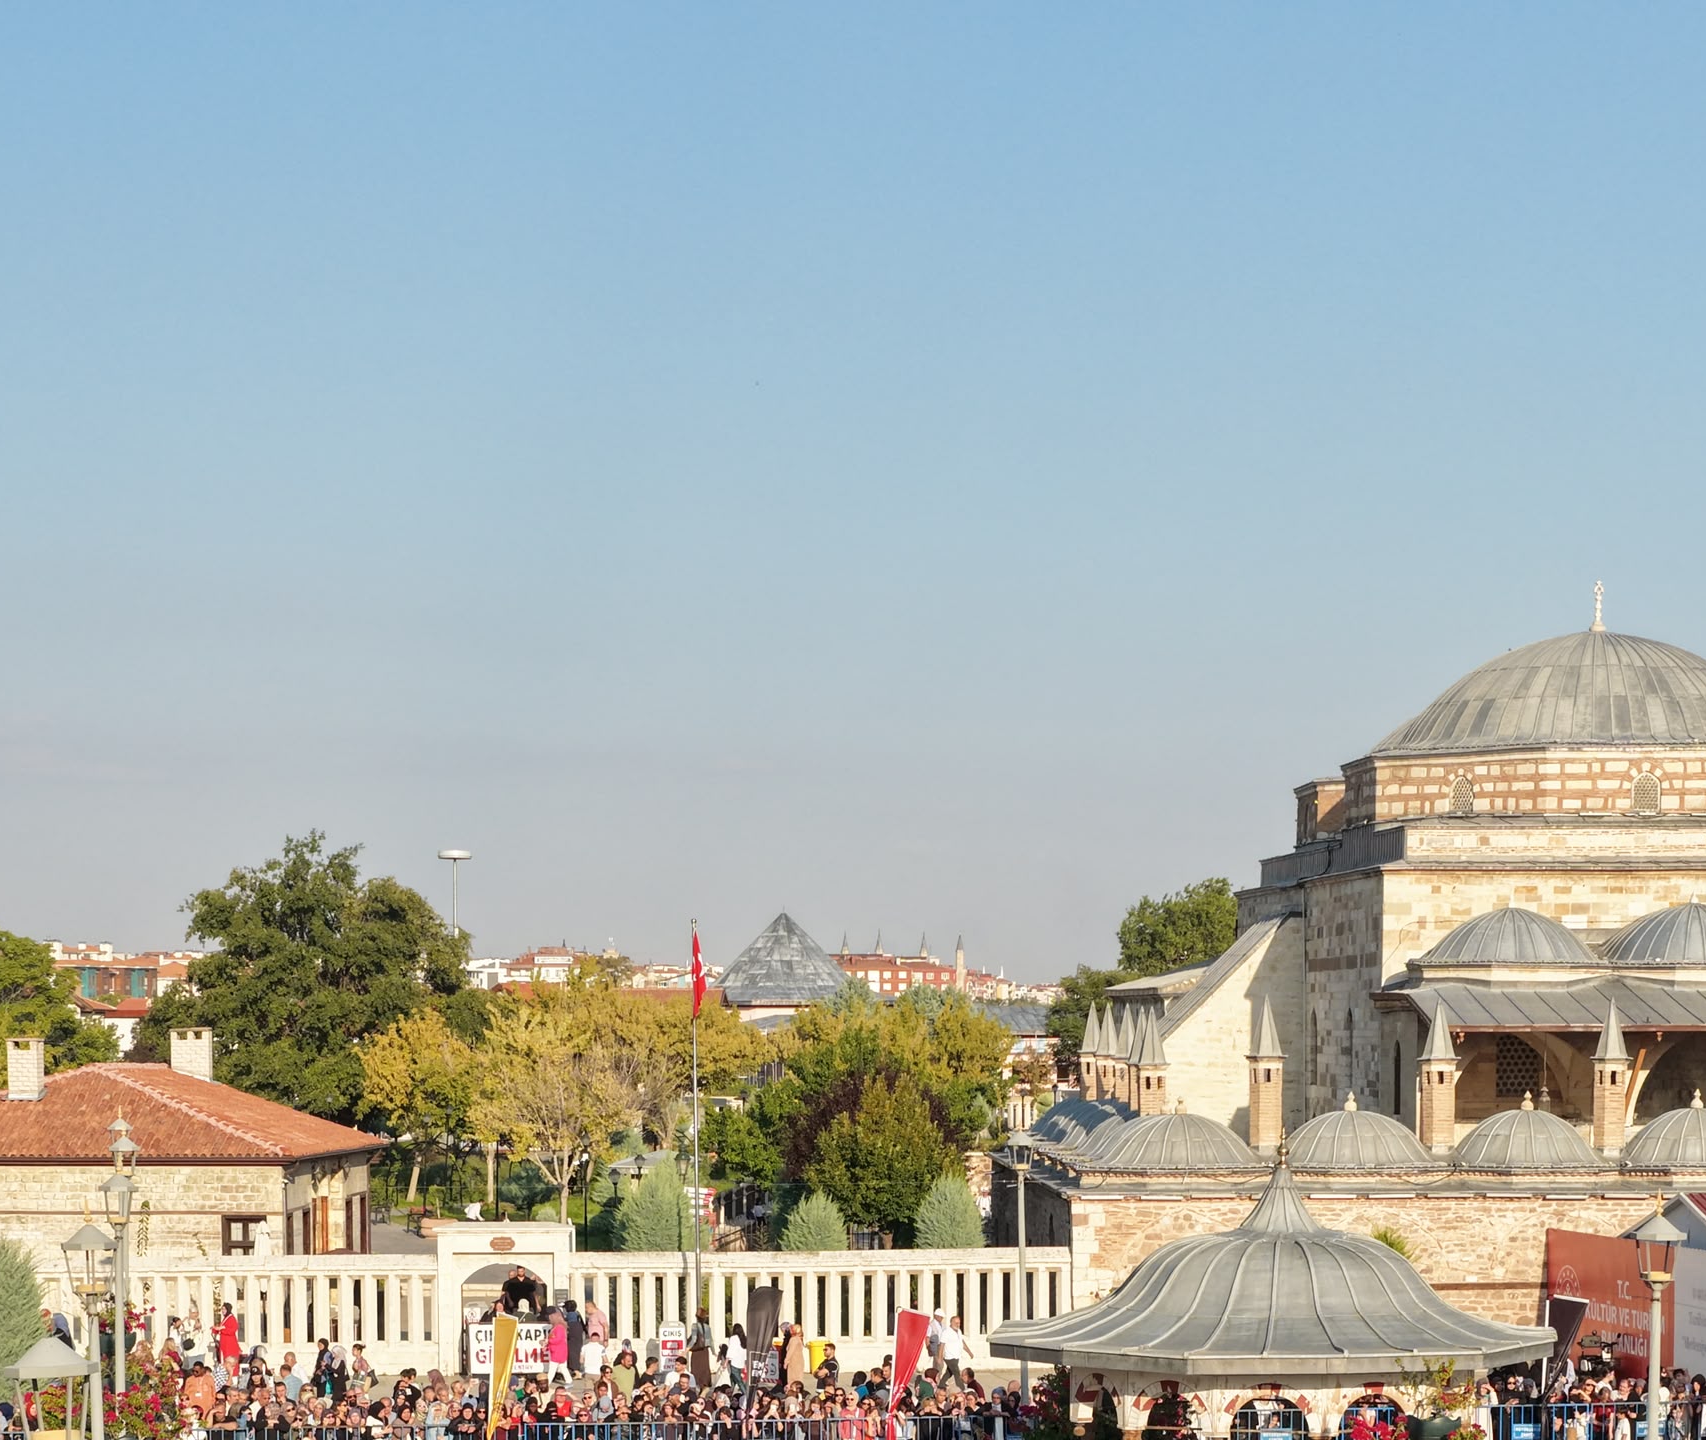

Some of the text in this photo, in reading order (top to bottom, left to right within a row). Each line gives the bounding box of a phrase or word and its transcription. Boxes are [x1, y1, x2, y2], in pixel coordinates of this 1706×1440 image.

[1617, 1280, 1632, 1300] T.C.
[1585, 1298, 1618, 1325] KÜLTÜR
[1618, 1307, 1630, 1327] VE
